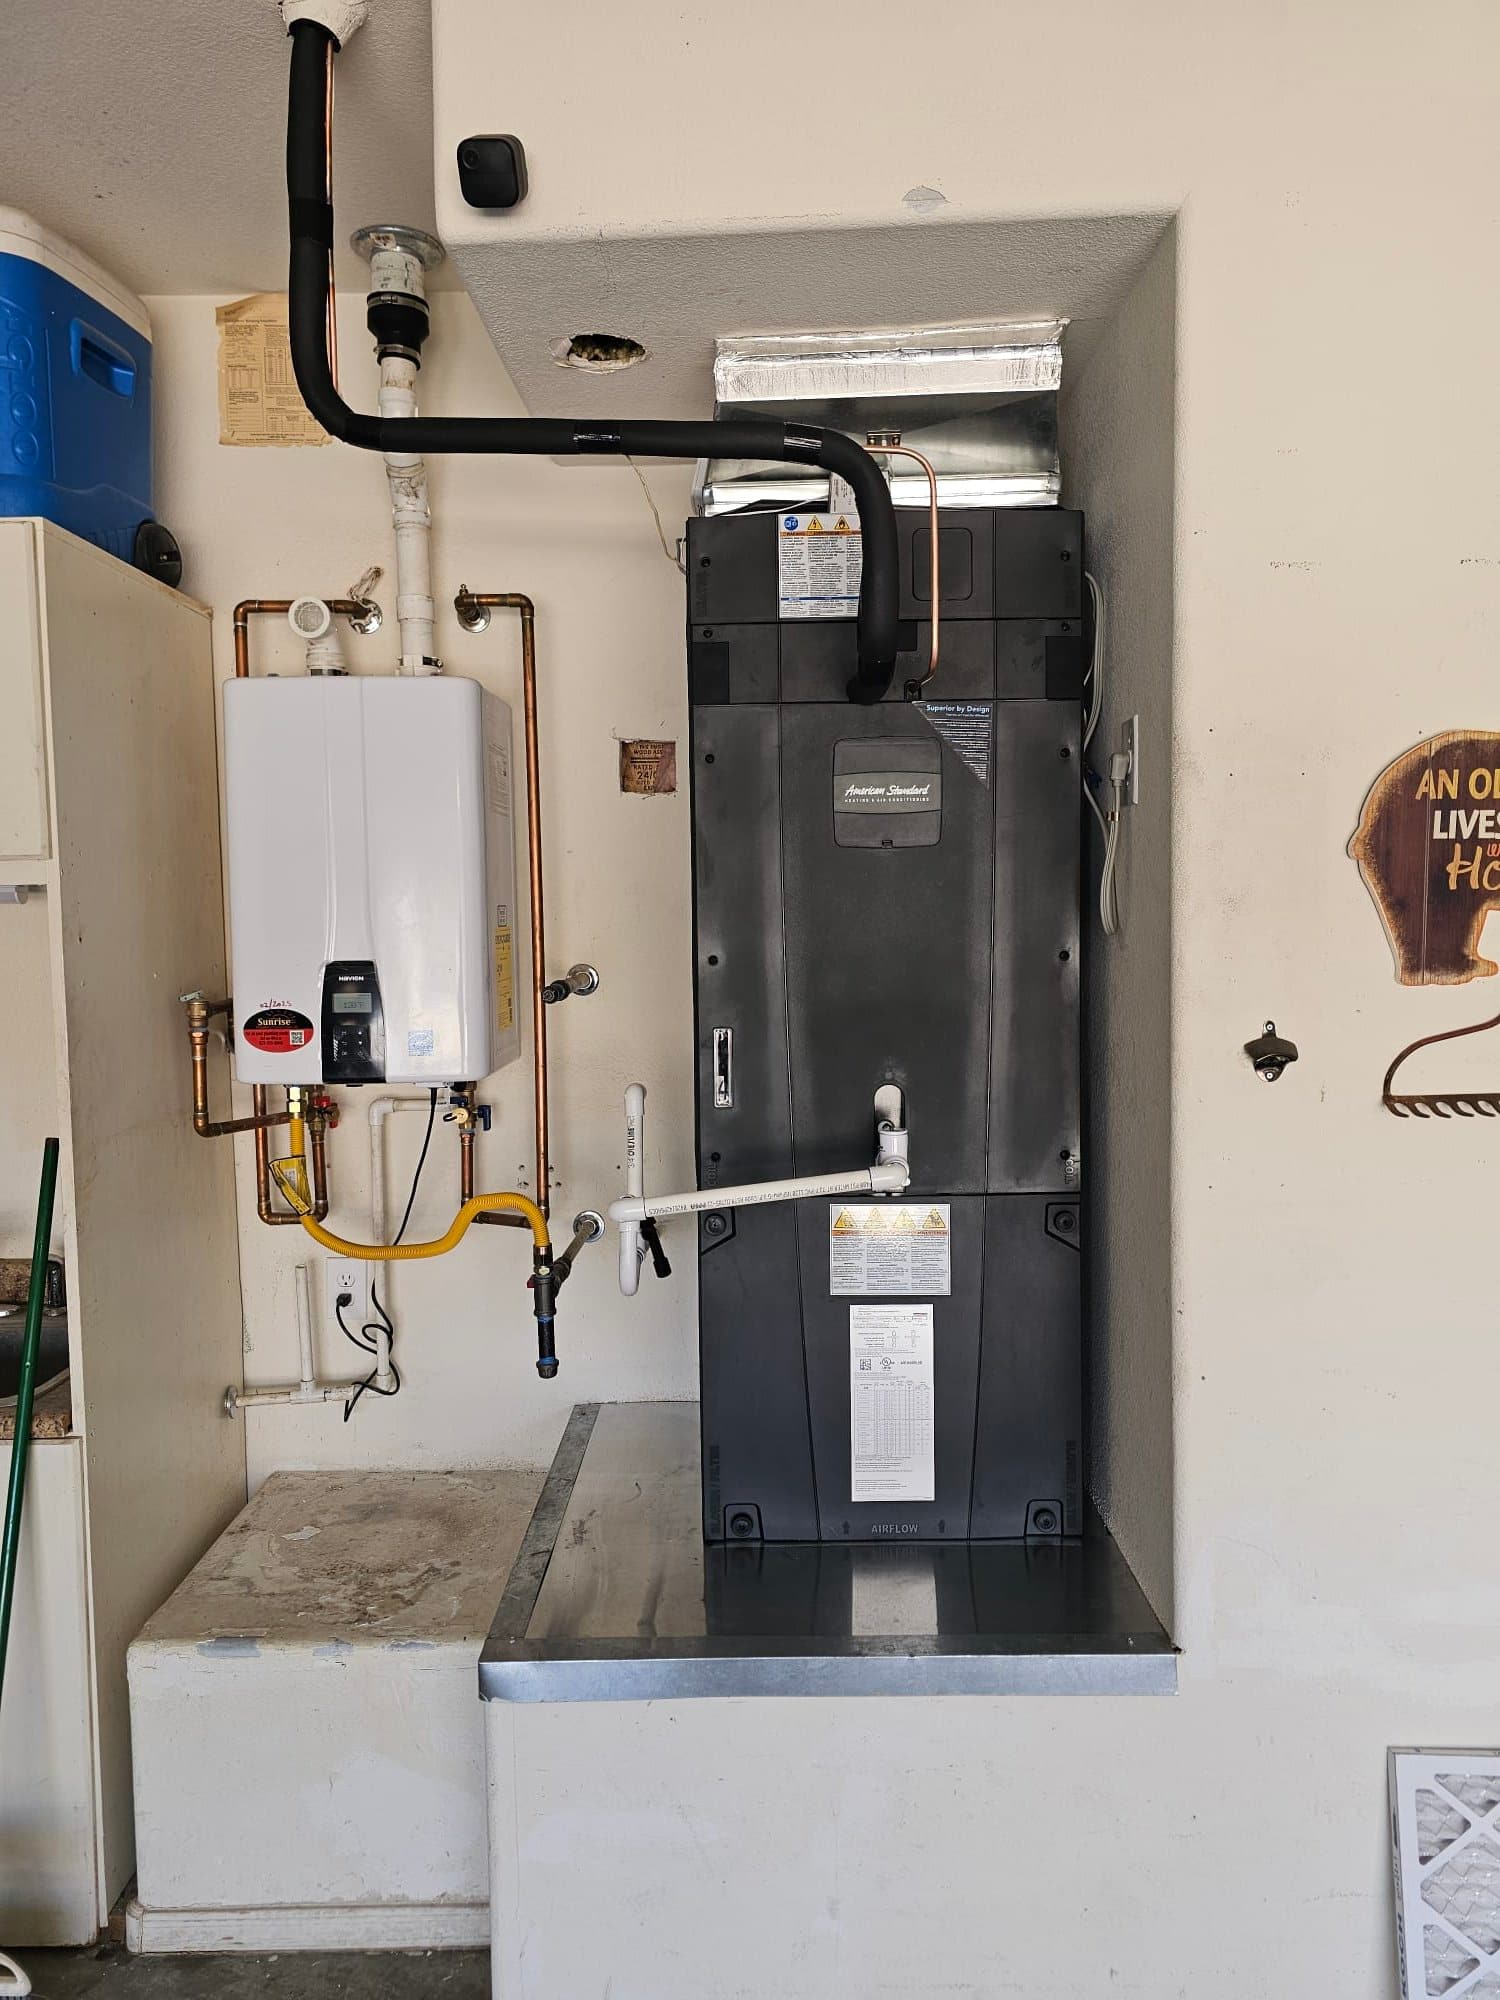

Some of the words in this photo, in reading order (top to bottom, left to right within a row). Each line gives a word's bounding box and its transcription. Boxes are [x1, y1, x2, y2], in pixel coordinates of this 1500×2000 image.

[926, 704, 955, 713] Superior
[956, 705, 965, 713] by
[967, 705, 990, 714] Design
[1415, 767, 1460, 800] AN
[844, 784, 886, 797] American
[886, 784, 930, 796] Standard
[257, 1018, 291, 1026] Sunrise
[871, 1522, 919, 1534] AIRFLOW
